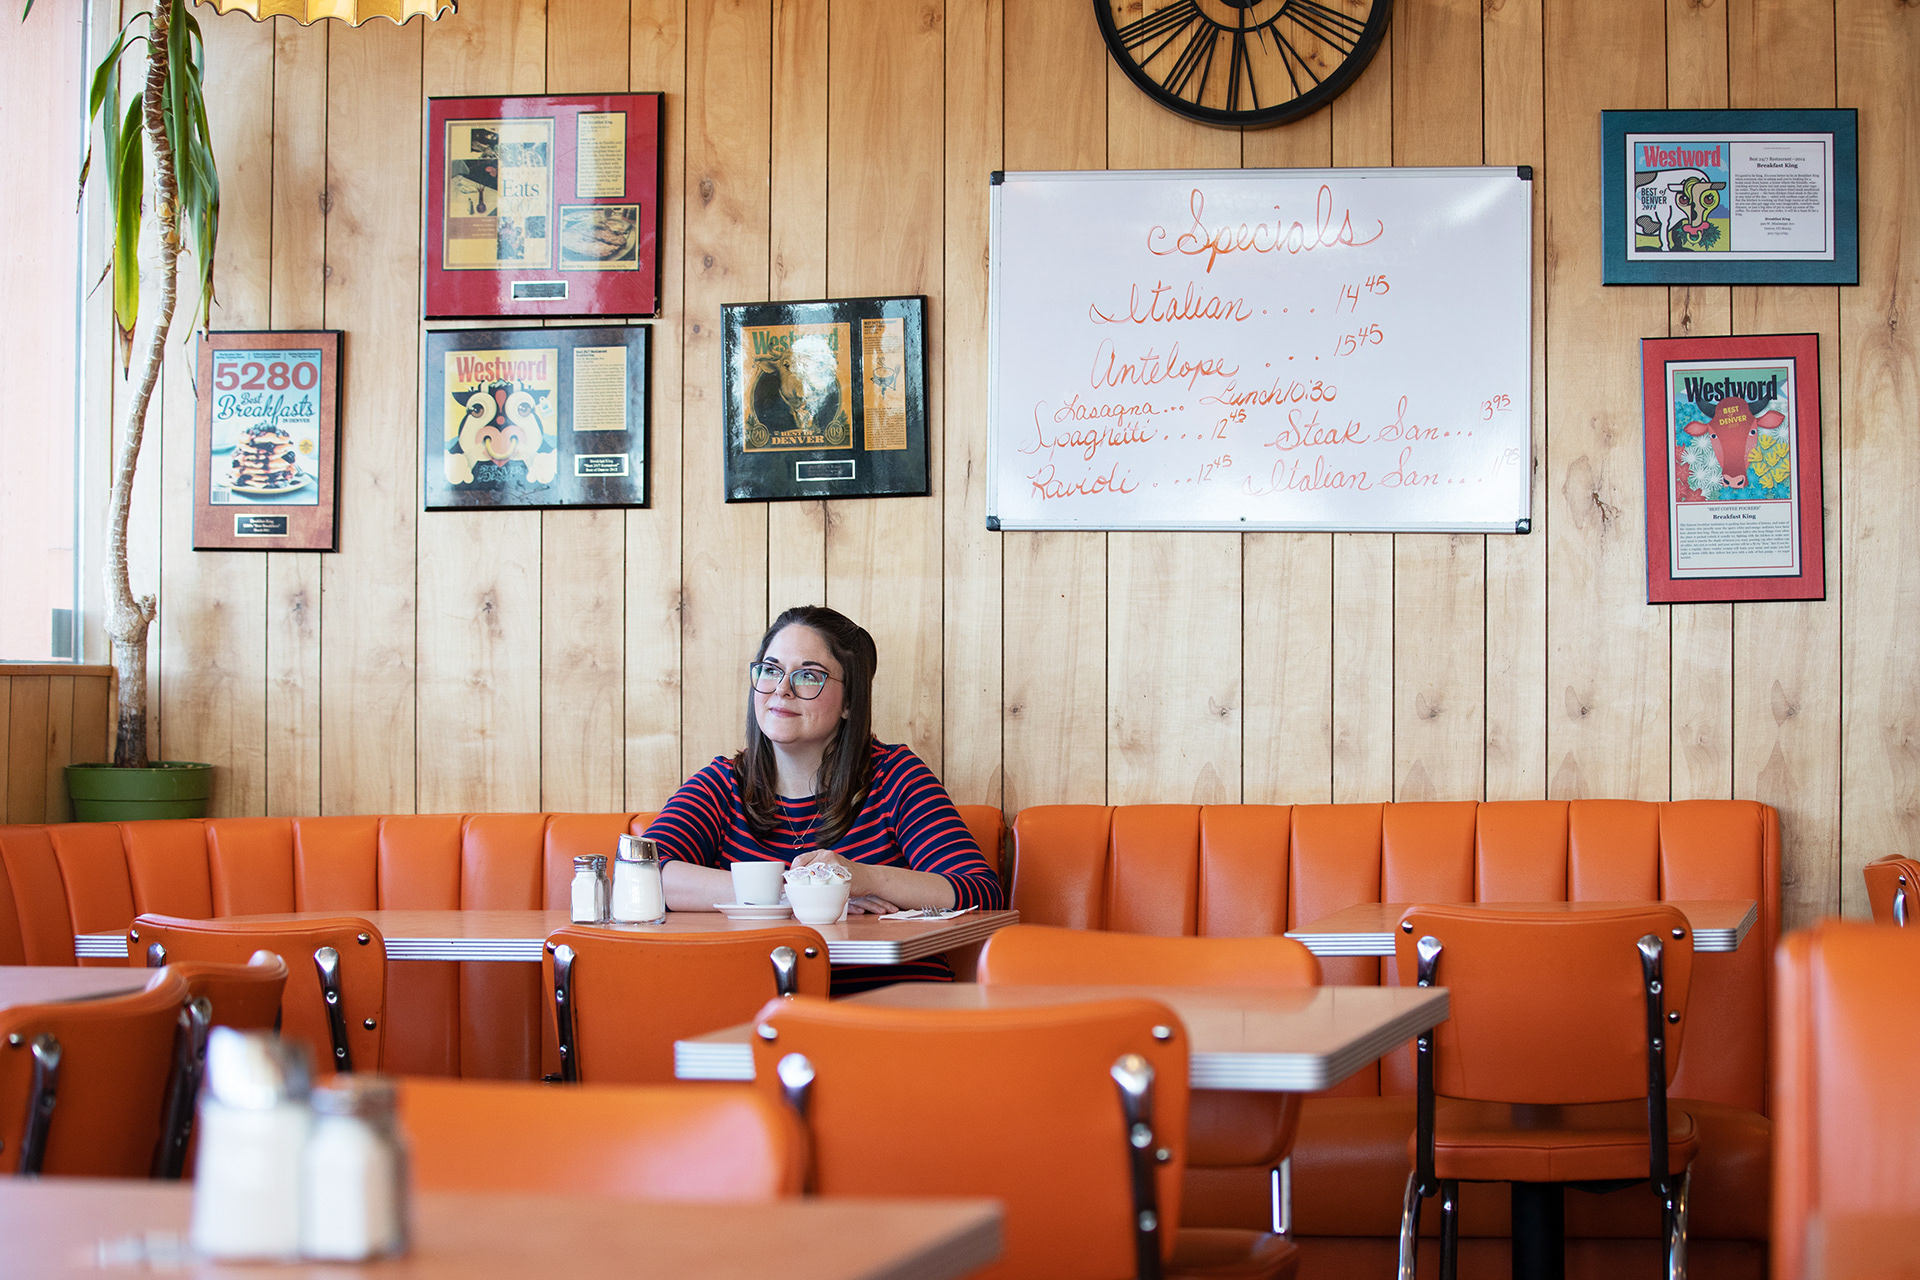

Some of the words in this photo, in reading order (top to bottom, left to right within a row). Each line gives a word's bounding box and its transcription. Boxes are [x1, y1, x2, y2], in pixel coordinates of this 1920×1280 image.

[1643, 145, 1721, 167] Westword
[502, 179, 540, 198] Eats
[1640, 188, 1657, 196] BEST
[1659, 187, 1668, 196] of
[1641, 196, 1667, 204] DENVER
[1147, 184, 1384, 273] Specials
[1089, 280, 1253, 324] Italian
[215, 361, 318, 391] 5280
[456, 354, 548, 383] Westword
[1090, 338, 1240, 391] Antelope
[240, 391, 264, 405] Best
[1684, 374, 1778, 402] Westword
[217, 394, 315, 425] Breakfasts
[1719, 415, 1747, 426] DENVER
[1723, 405, 1740, 415] BEST
[754, 429, 765, 441] 20
[771, 435, 825, 445] DENVER
[830, 427, 841, 438] 09
[1263, 409, 1370, 451] Steak
[1026, 462, 1140, 501] Ravioli
[1241, 455, 1373, 496] Italian
